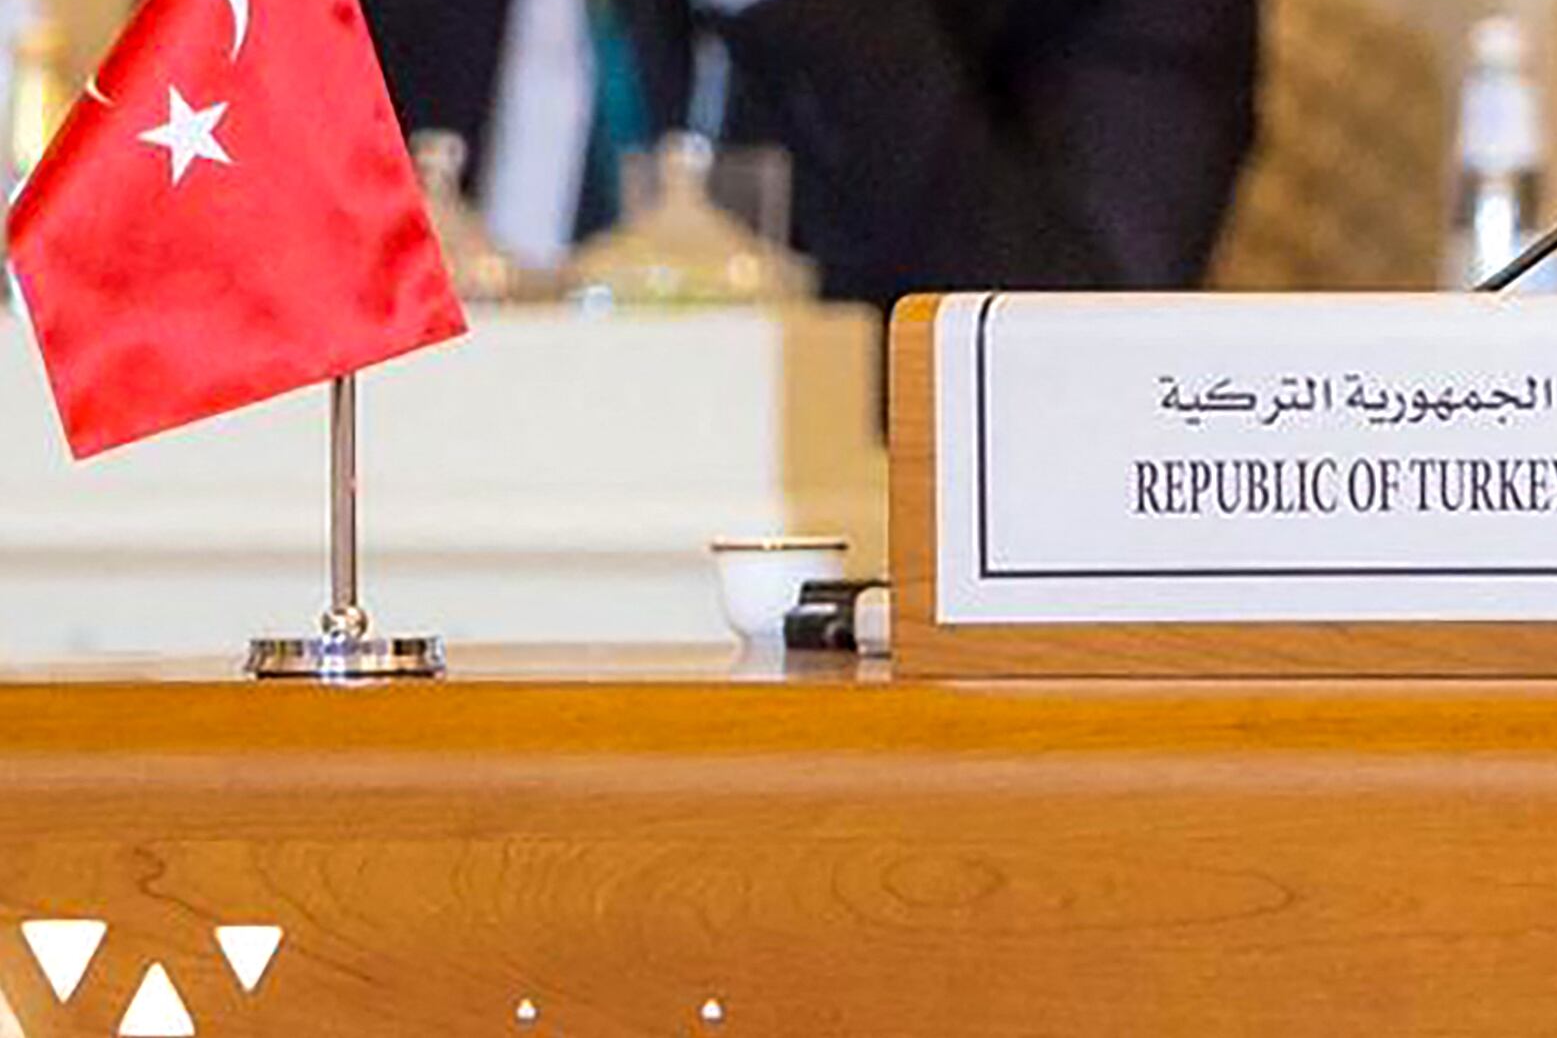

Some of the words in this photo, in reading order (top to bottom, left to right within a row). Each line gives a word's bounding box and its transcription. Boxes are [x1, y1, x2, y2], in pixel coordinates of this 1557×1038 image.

[1158, 376, 1332, 425] التركية
[1345, 374, 1552, 424] الجمهورية
[1135, 458, 1337, 514] REPUBLIC
[1347, 458, 1400, 512] OF
